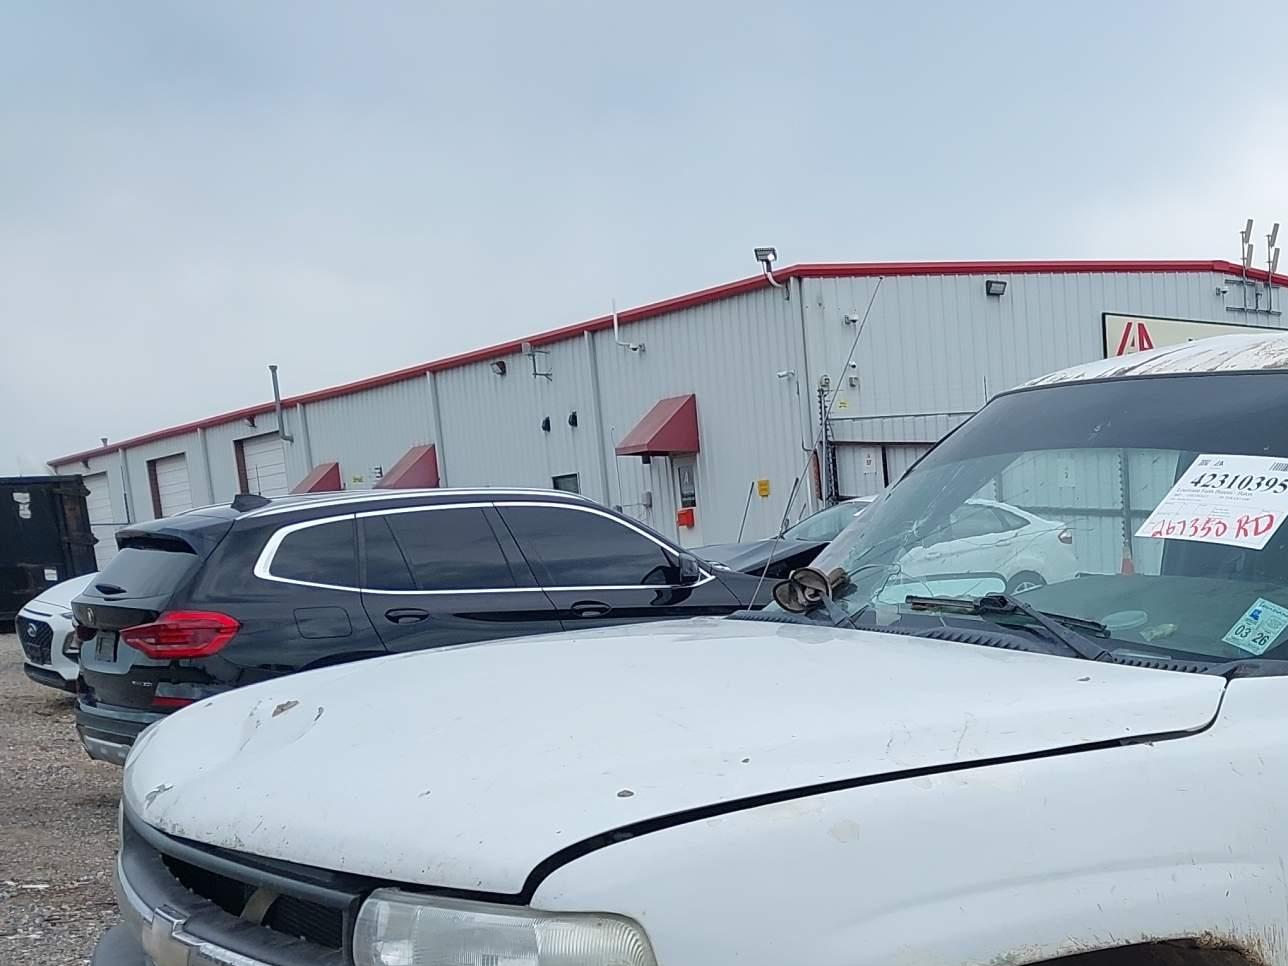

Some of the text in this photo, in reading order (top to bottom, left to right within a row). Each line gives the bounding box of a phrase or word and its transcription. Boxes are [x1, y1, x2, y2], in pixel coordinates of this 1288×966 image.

[1235, 514, 1275, 538] RD
[1234, 625, 1251, 638] 03
[1252, 632, 1269, 646] 26
